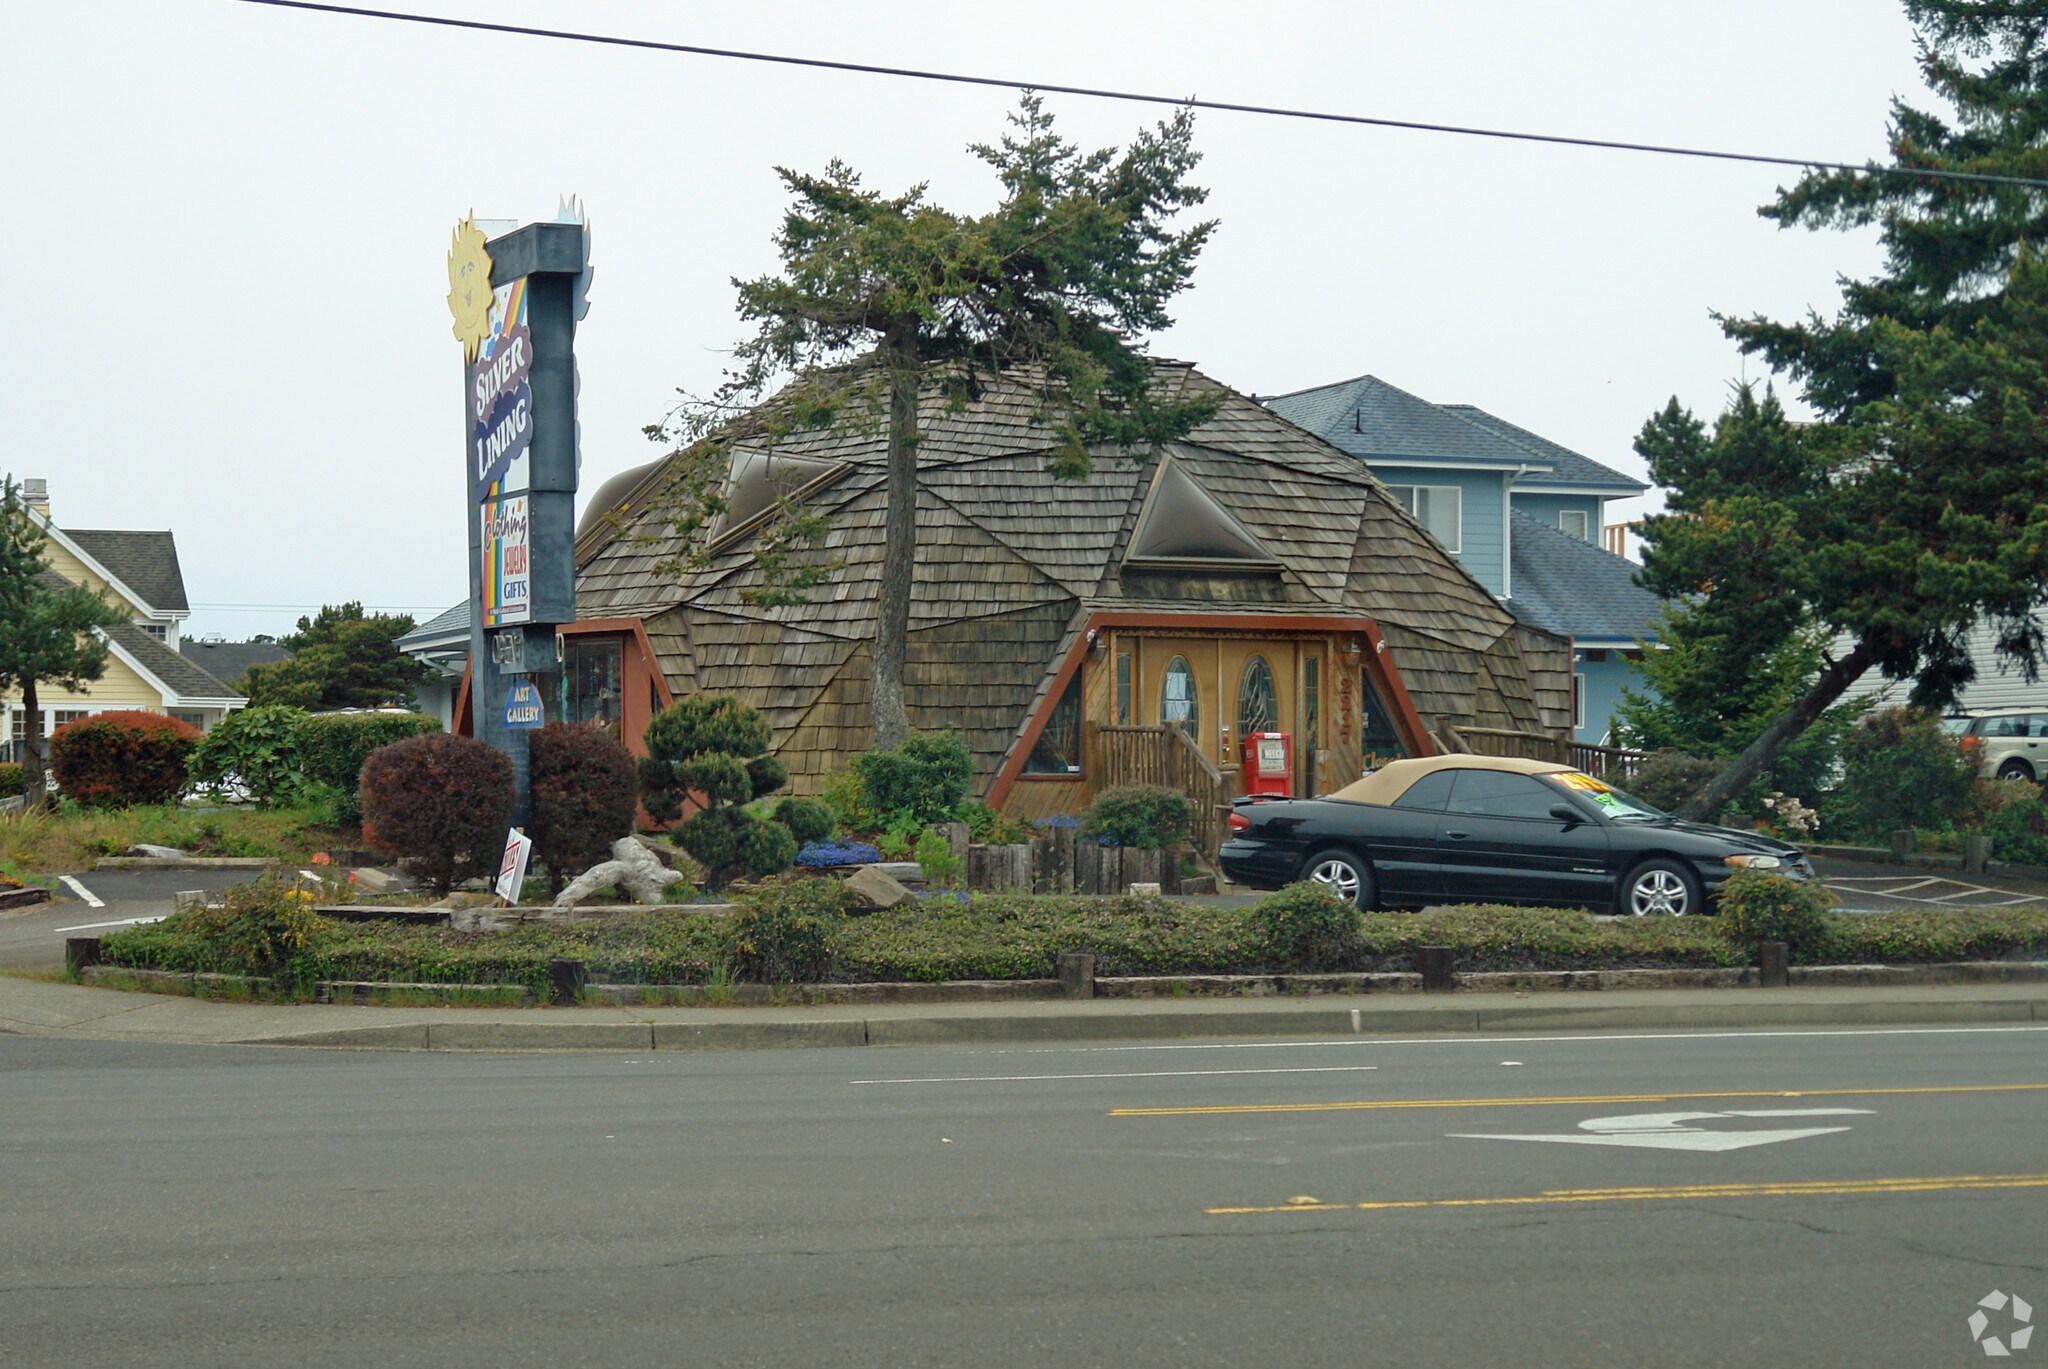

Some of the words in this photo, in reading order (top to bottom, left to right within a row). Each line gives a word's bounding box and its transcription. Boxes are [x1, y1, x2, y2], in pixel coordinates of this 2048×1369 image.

[476, 336, 525, 417] SILVER
[477, 398, 526, 481] LINING
[484, 505, 527, 551] Clothing
[503, 580, 527, 599] GIFTS
[514, 686, 531, 702] ART
[506, 706, 539, 723] GALLERY
[1362, 751, 1401, 771] Close
